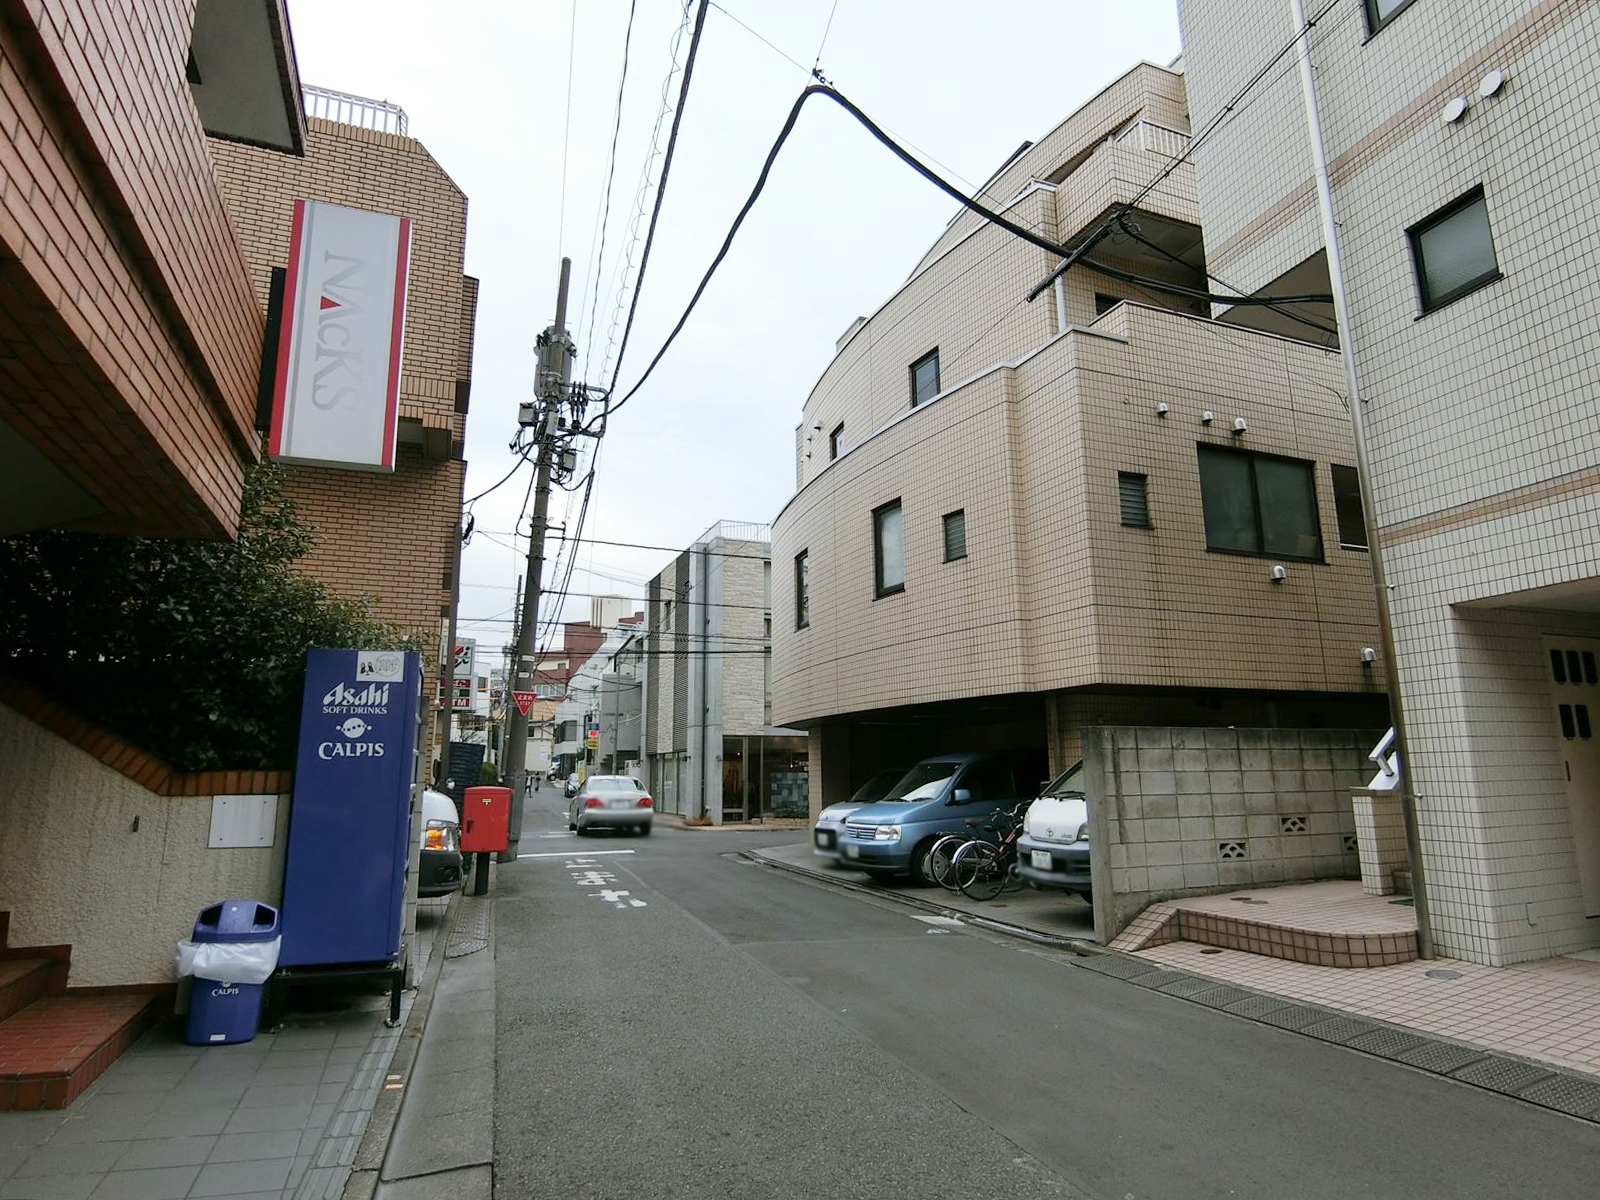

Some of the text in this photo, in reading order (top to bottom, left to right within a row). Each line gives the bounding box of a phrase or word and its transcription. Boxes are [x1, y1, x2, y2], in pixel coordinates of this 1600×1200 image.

[323, 682, 389, 706] Asahi
[322, 706, 387, 714] SOFT DRINKS
[318, 742, 385, 760] CALPIS
[211, 988, 240, 997] CALPIS
